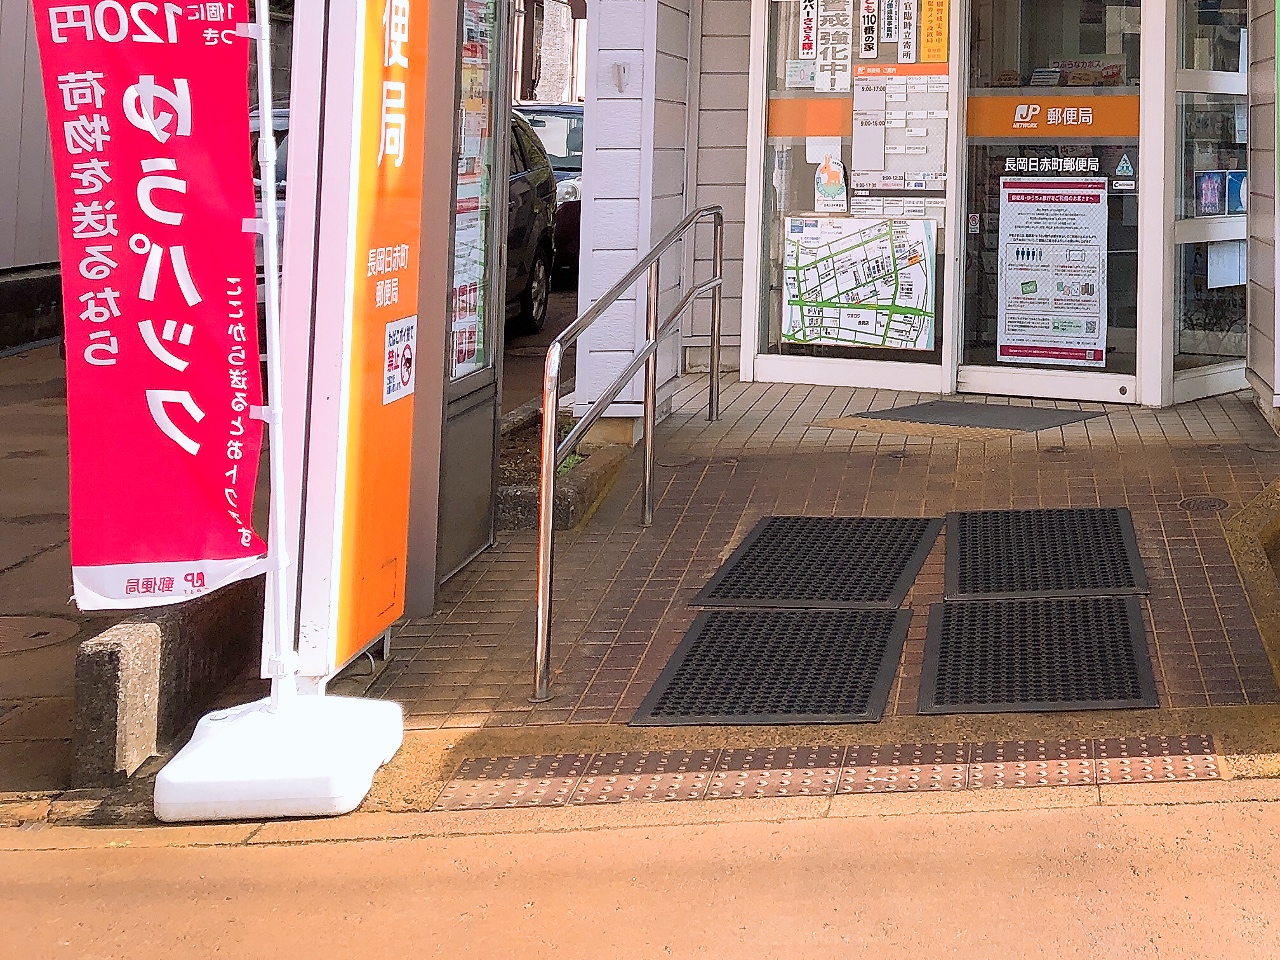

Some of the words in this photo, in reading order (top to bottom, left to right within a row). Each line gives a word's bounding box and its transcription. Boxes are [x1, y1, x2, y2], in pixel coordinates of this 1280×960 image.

[1014, 104, 1041, 122] JP
[1047, 107, 1094, 126] 郵便局
[1004, 156, 1100, 172] 長岡日赤町郵便局
[366, 243, 410, 278] 長岡日赤町
[375, 277, 400, 308] 郵便局
